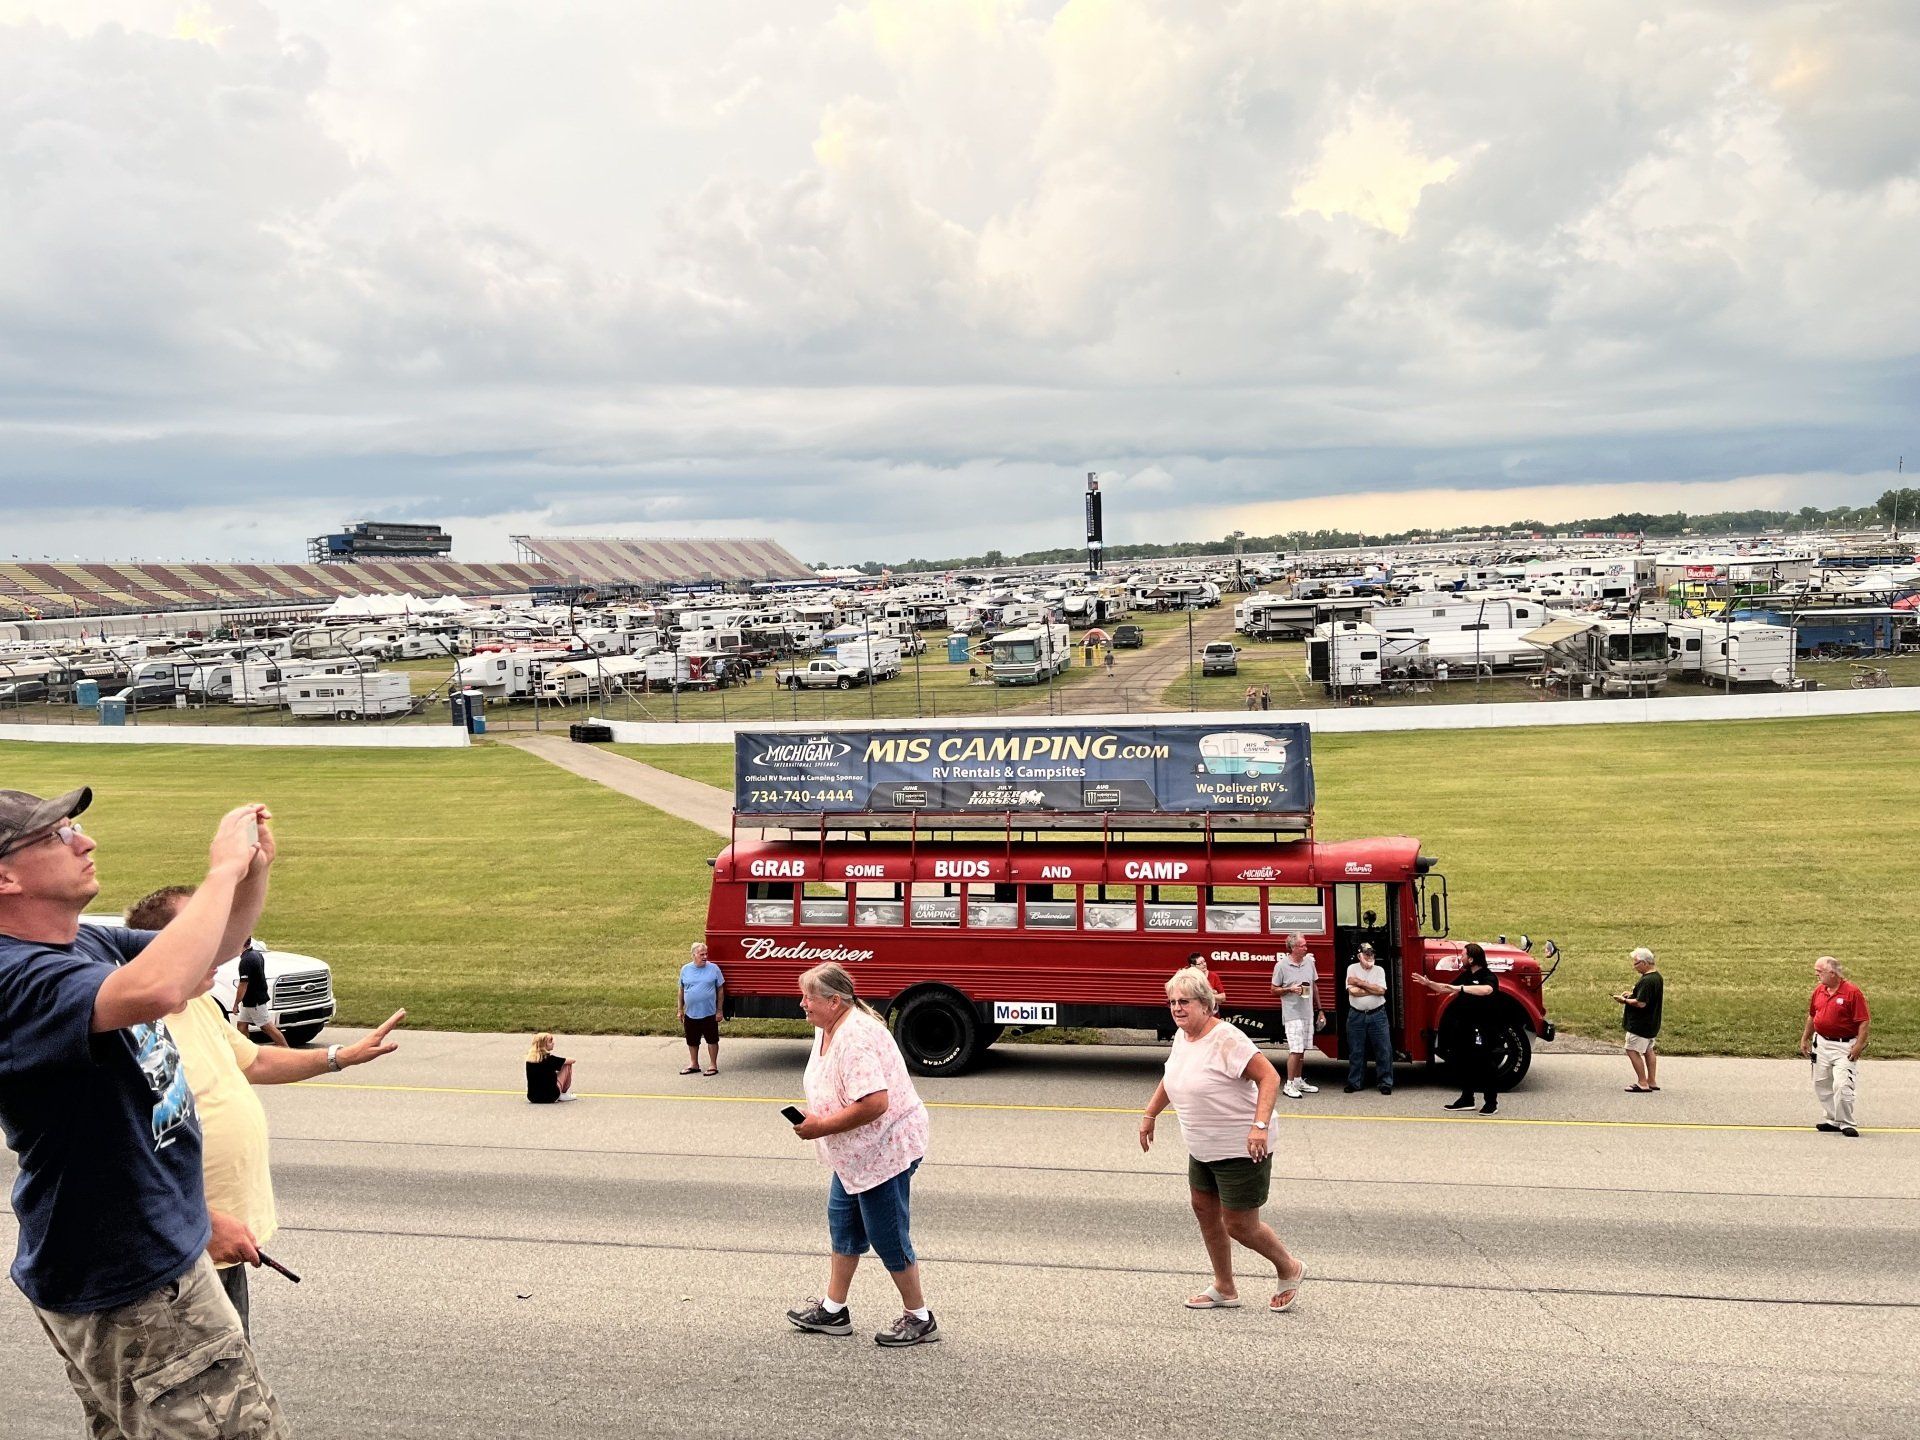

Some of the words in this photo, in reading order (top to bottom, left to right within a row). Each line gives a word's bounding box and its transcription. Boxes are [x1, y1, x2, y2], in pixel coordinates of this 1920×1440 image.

[765, 744, 835, 762] MICHIGAN
[862, 738, 932, 763] MIS
[932, 767, 949, 779] RV
[952, 766, 1001, 779] Rentals
[1003, 767, 1014, 779] &
[1016, 765, 1086, 780] Campsites
[745, 774, 768, 782] Official
[778, 774, 800, 782] Rental
[806, 774, 835, 783] Camping
[836, 774, 864, 782] Sponsor
[1195, 783, 1214, 793] We
[1216, 783, 1258, 793] Deliver
[751, 789, 854, 803] 734-740-4444
[971, 790, 1021, 798] FASTER
[967, 797, 1019, 805] HORSES
[1212, 794, 1234, 804] You
[1236, 793, 1272, 806] Enjoy.
[750, 859, 805, 878] GRAB
[845, 864, 885, 877] SOME
[934, 860, 990, 878] BUDS
[1041, 865, 1072, 879] AND
[1124, 861, 1189, 880] CAMP
[1243, 869, 1274, 878] MICHIGAN
[918, 903, 936, 911] MIS
[804, 909, 843, 918] Budweiser
[915, 910, 956, 918] CAMPING
[1029, 911, 1071, 920] Budweiser
[1151, 911, 1171, 919] MIS
[1148, 918, 1193, 927] CAMPING
[1273, 914, 1319, 924] Budweiser
[740, 937, 874, 962] Budweiser
[1211, 951, 1250, 962] GRAB
[1250, 954, 1276, 962] SOME
[997, 1005, 1038, 1019] Mobil
[923, 1047, 960, 1066] GOODYEAR
